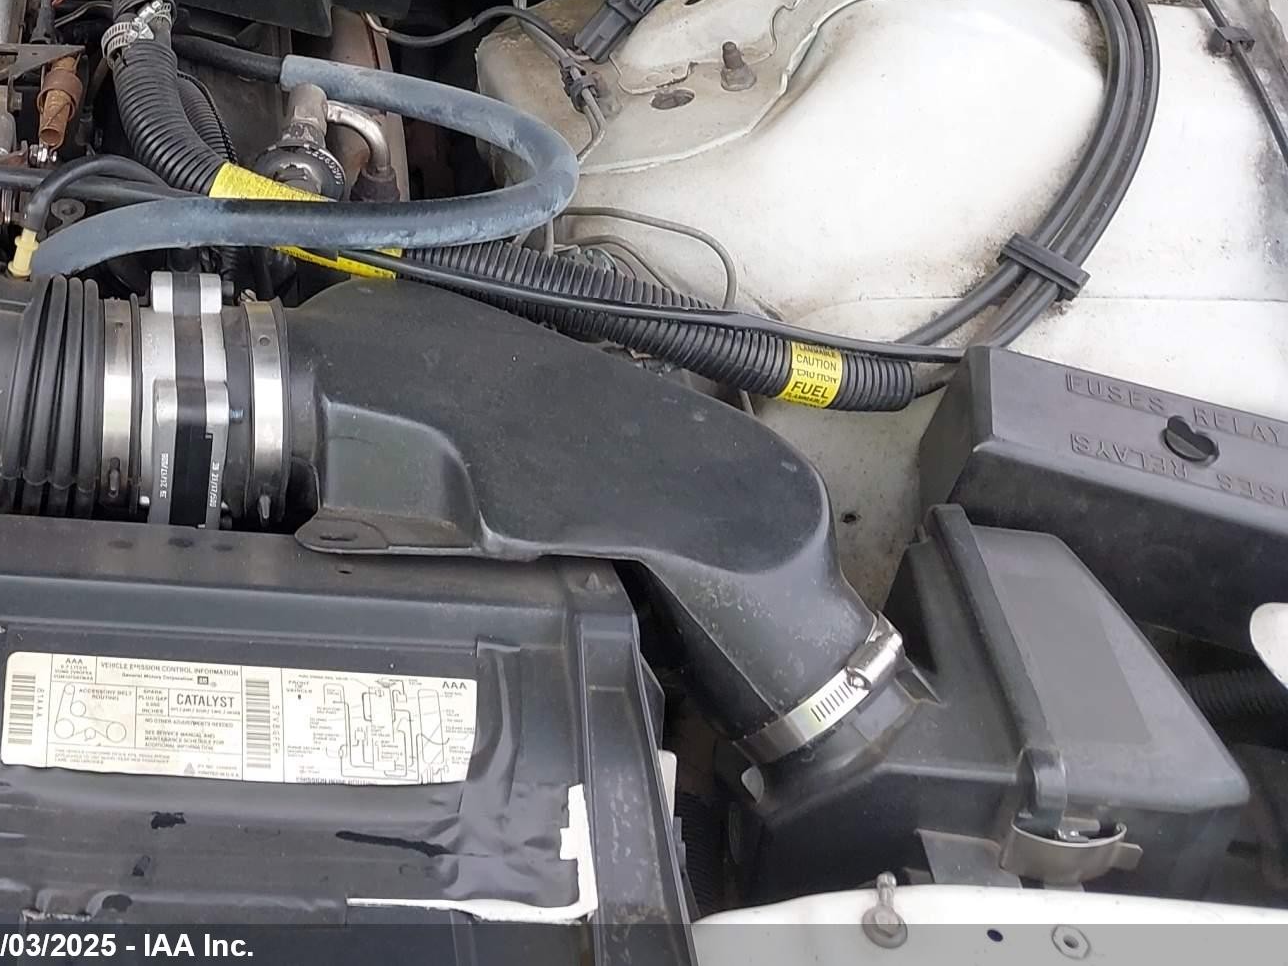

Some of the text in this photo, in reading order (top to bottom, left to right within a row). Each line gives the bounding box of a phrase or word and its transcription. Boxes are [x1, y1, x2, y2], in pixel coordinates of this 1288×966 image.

[796, 354, 837, 371] CAUTION
[790, 381, 829, 399] FUEL
[1065, 370, 1164, 413] FUSES
[101, 662, 238, 676] VEHICLE EMISSION CONTROL INFORMATION
[443, 681, 467, 690] AAA
[177, 694, 234, 708] CATALYST
